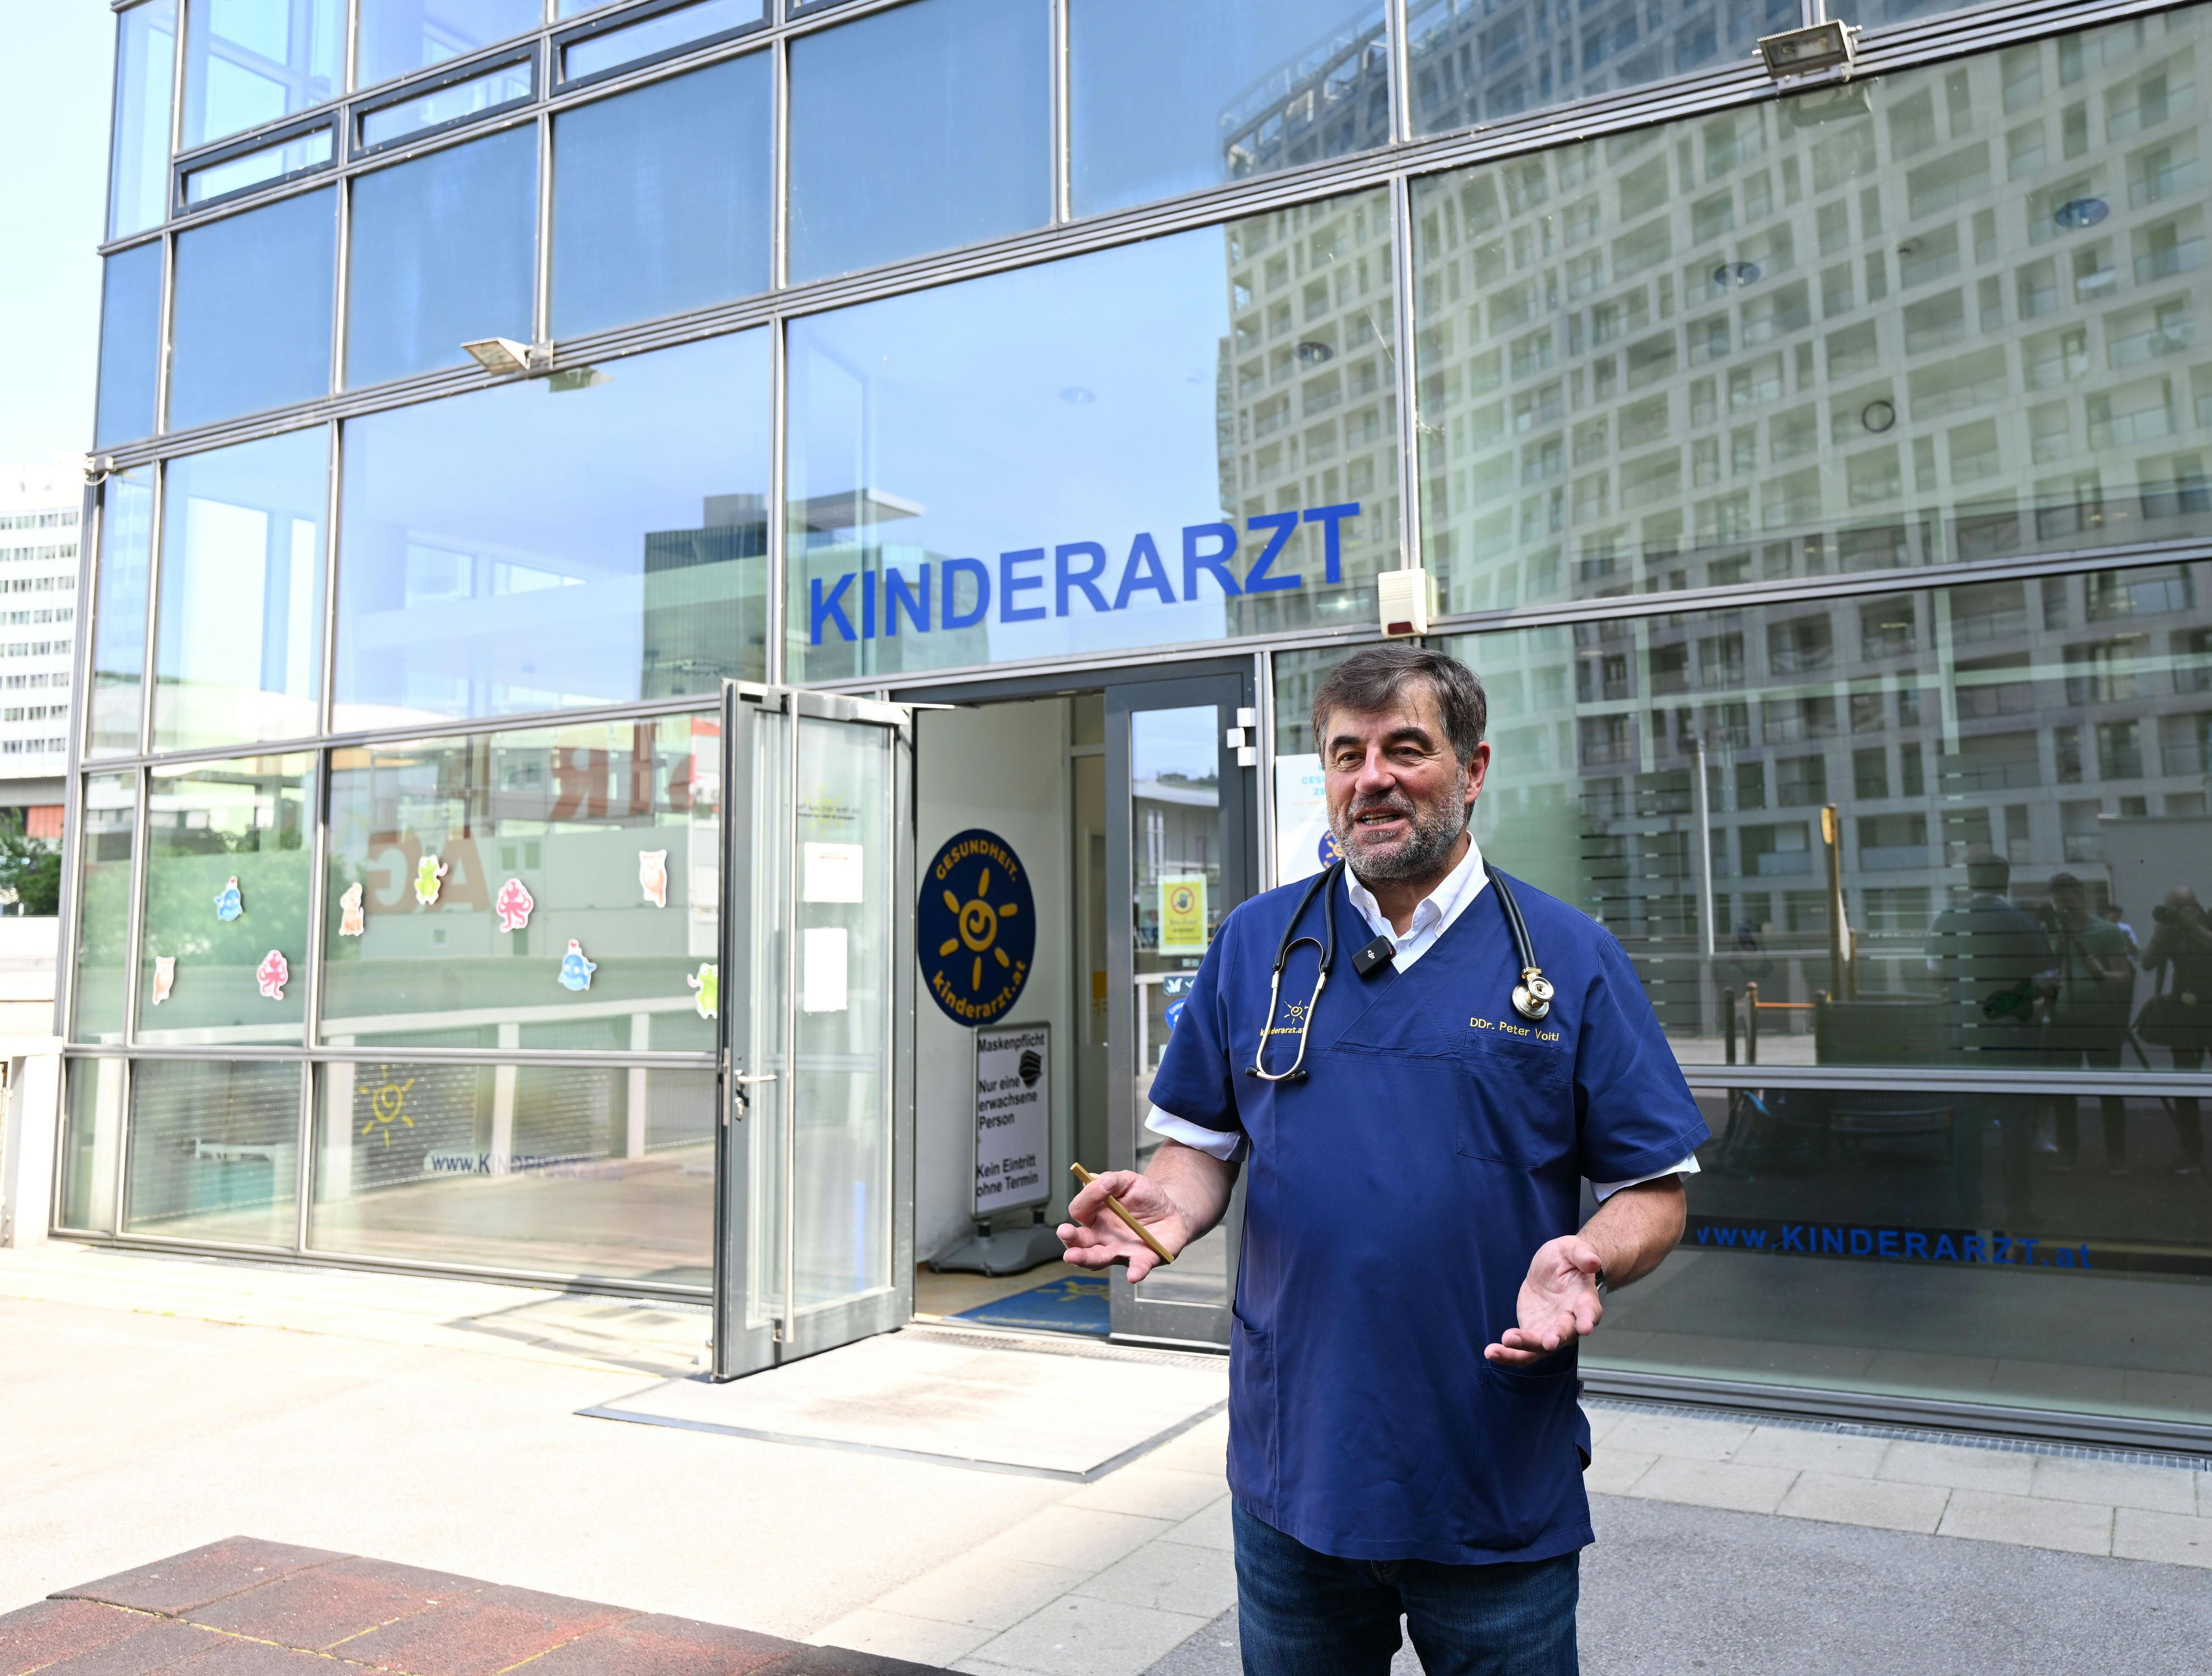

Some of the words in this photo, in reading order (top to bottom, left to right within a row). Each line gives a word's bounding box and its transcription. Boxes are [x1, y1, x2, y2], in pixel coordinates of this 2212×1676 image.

[811, 502, 1361, 646] KINDERARZT
[936, 839, 1018, 882] GESUNDHEIT.
[932, 960, 1026, 1018] kinderarzt.at
[1470, 1017, 1495, 1029] DDr.
[1499, 1021, 1530, 1036] Peter
[1535, 1028, 1559, 1042] Voitl
[978, 1033, 1045, 1052] Maskenpflicht
[978, 1080, 998, 1094] Nur
[999, 1075, 1021, 1090] eine
[978, 1091, 1038, 1112] erwachsene
[979, 1113, 1015, 1130] Person
[976, 1162, 1000, 1178] Kein
[1003, 1153, 1036, 1173] Eintritt
[976, 1181, 1003, 1197] ohne
[1004, 1171, 1039, 1190] Termin
